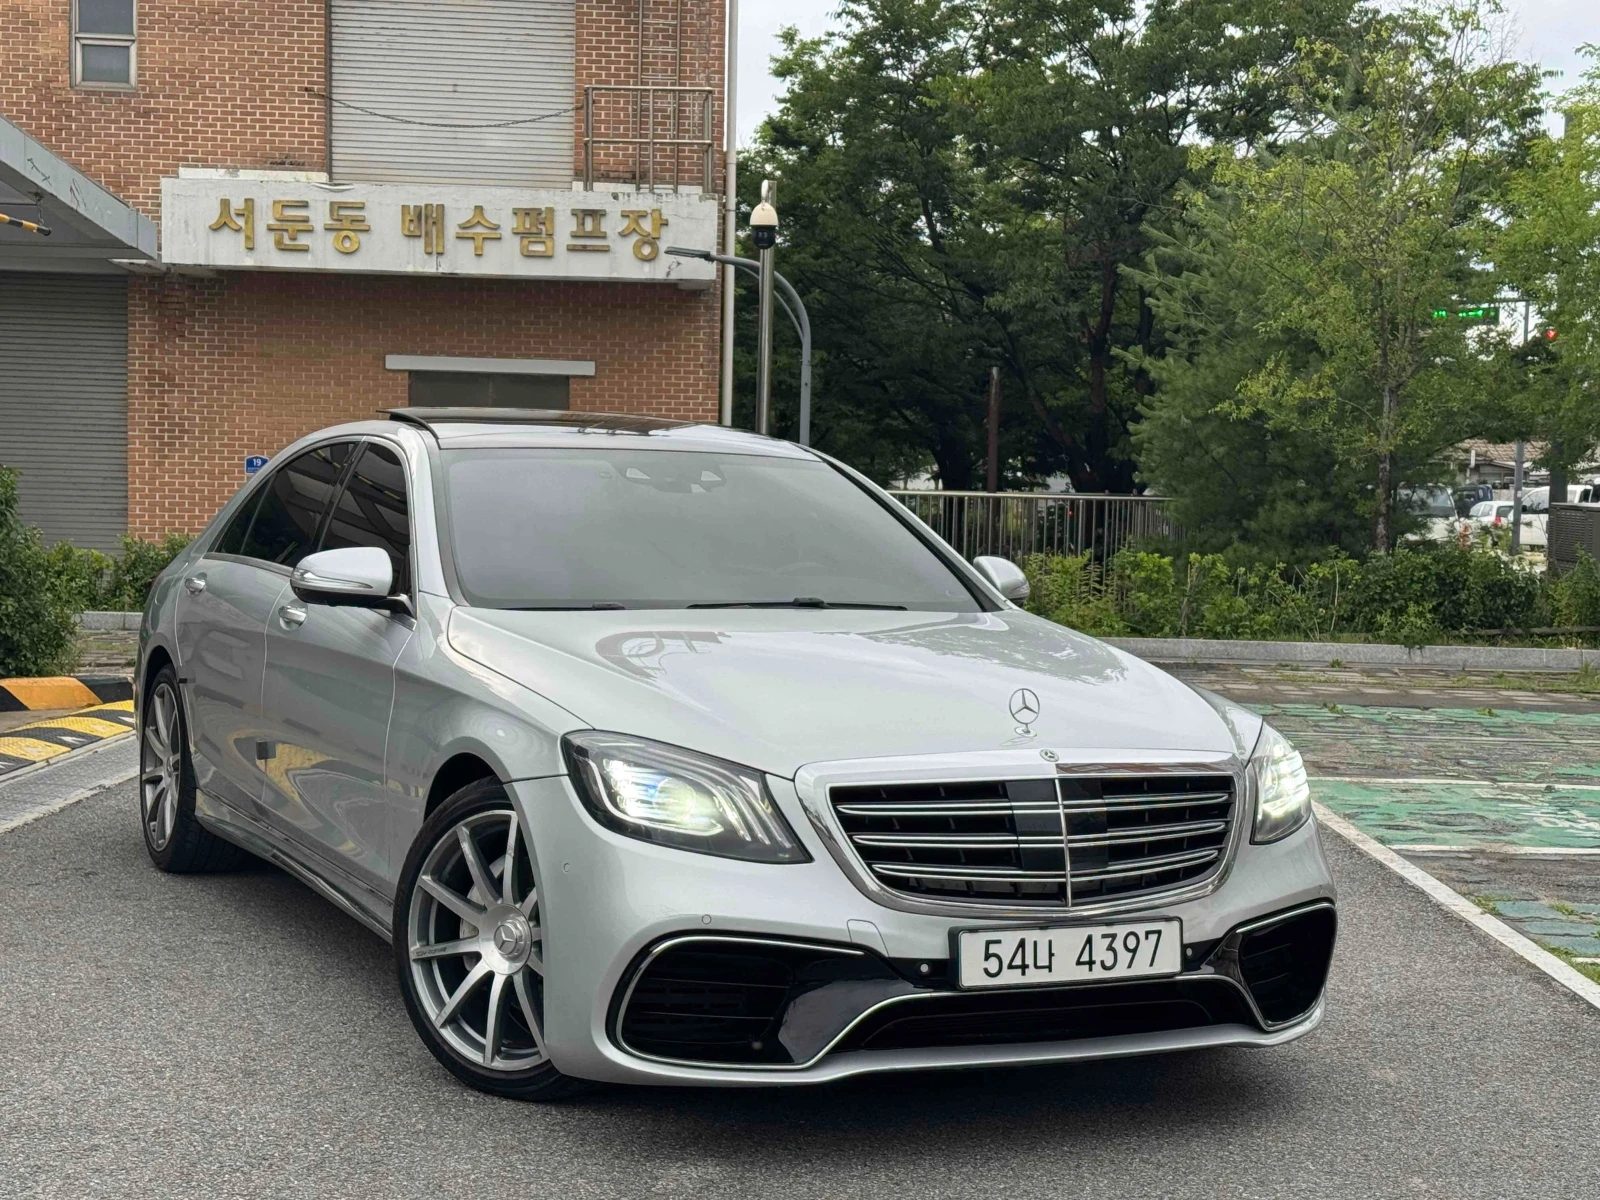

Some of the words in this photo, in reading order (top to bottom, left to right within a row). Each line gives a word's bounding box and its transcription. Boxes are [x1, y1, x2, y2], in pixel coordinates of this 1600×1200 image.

[209, 198, 371, 253] 서둔동
[401, 203, 668, 261] 배수펌프장
[252, 458, 262, 467] 19
[983, 937, 1055, 978] 54나
[1075, 929, 1163, 972] 4397
